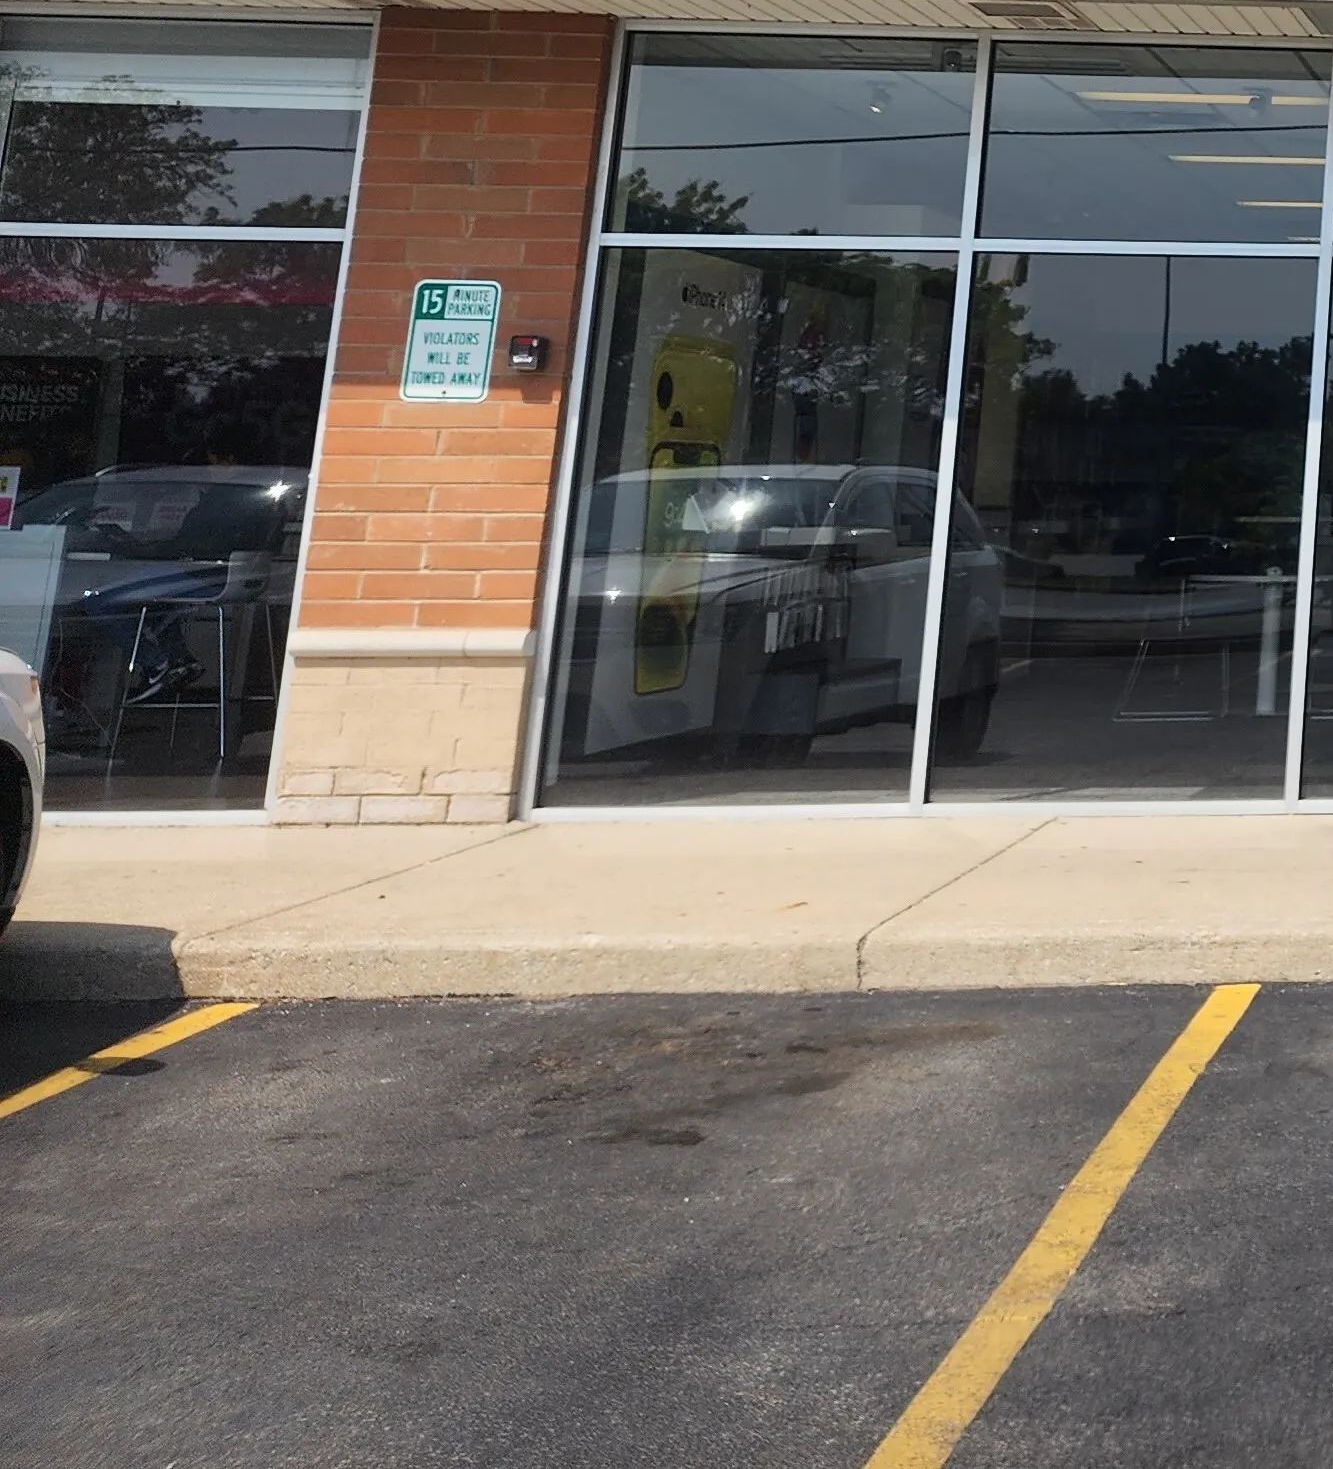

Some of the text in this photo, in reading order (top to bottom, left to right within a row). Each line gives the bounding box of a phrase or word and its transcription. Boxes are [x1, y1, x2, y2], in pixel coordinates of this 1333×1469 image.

[421, 288, 444, 314] 15
[452, 288, 491, 302] MINUTE
[447, 302, 492, 316] PARKING
[423, 332, 480, 345] VIOLATORS
[427, 351, 471, 365] WILL BE
[410, 371, 482, 386] TOWED AWAY
